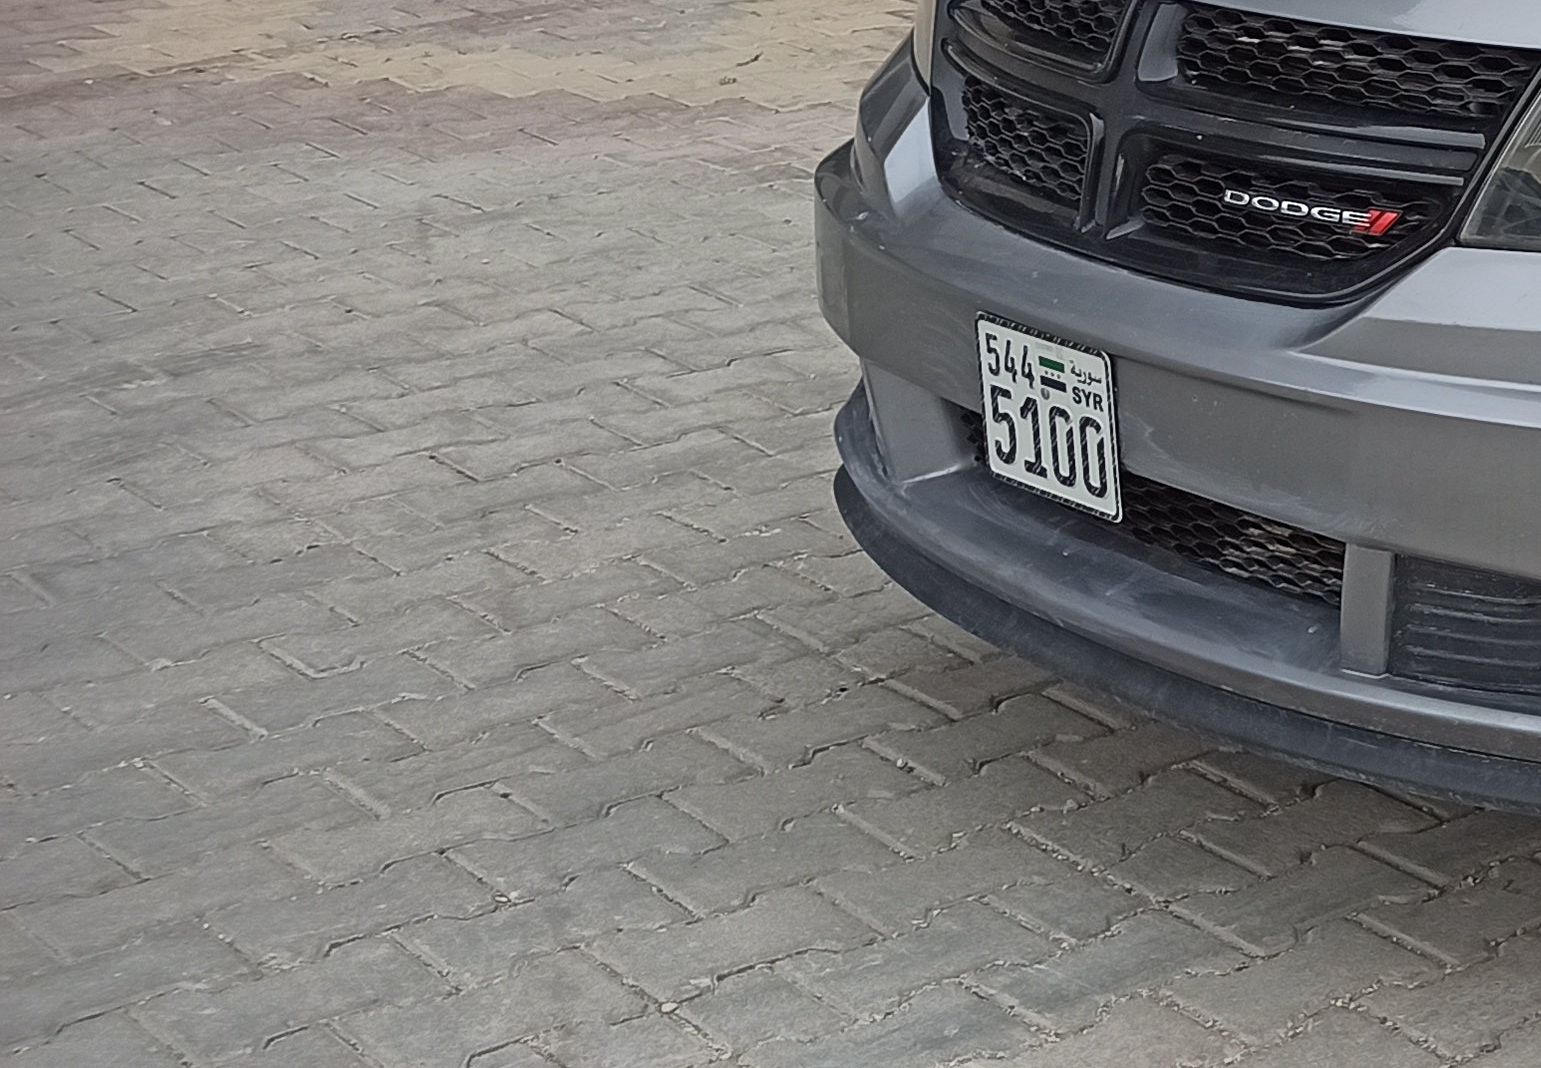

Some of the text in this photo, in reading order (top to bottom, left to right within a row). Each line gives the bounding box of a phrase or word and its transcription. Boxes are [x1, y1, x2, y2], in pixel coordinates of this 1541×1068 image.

[1224, 189, 1372, 227] DODGE
[985, 332, 1035, 389] 544
[1069, 360, 1103, 385] سورية
[1072, 386, 1104, 412] SYR
[990, 384, 1108, 498] 5100
